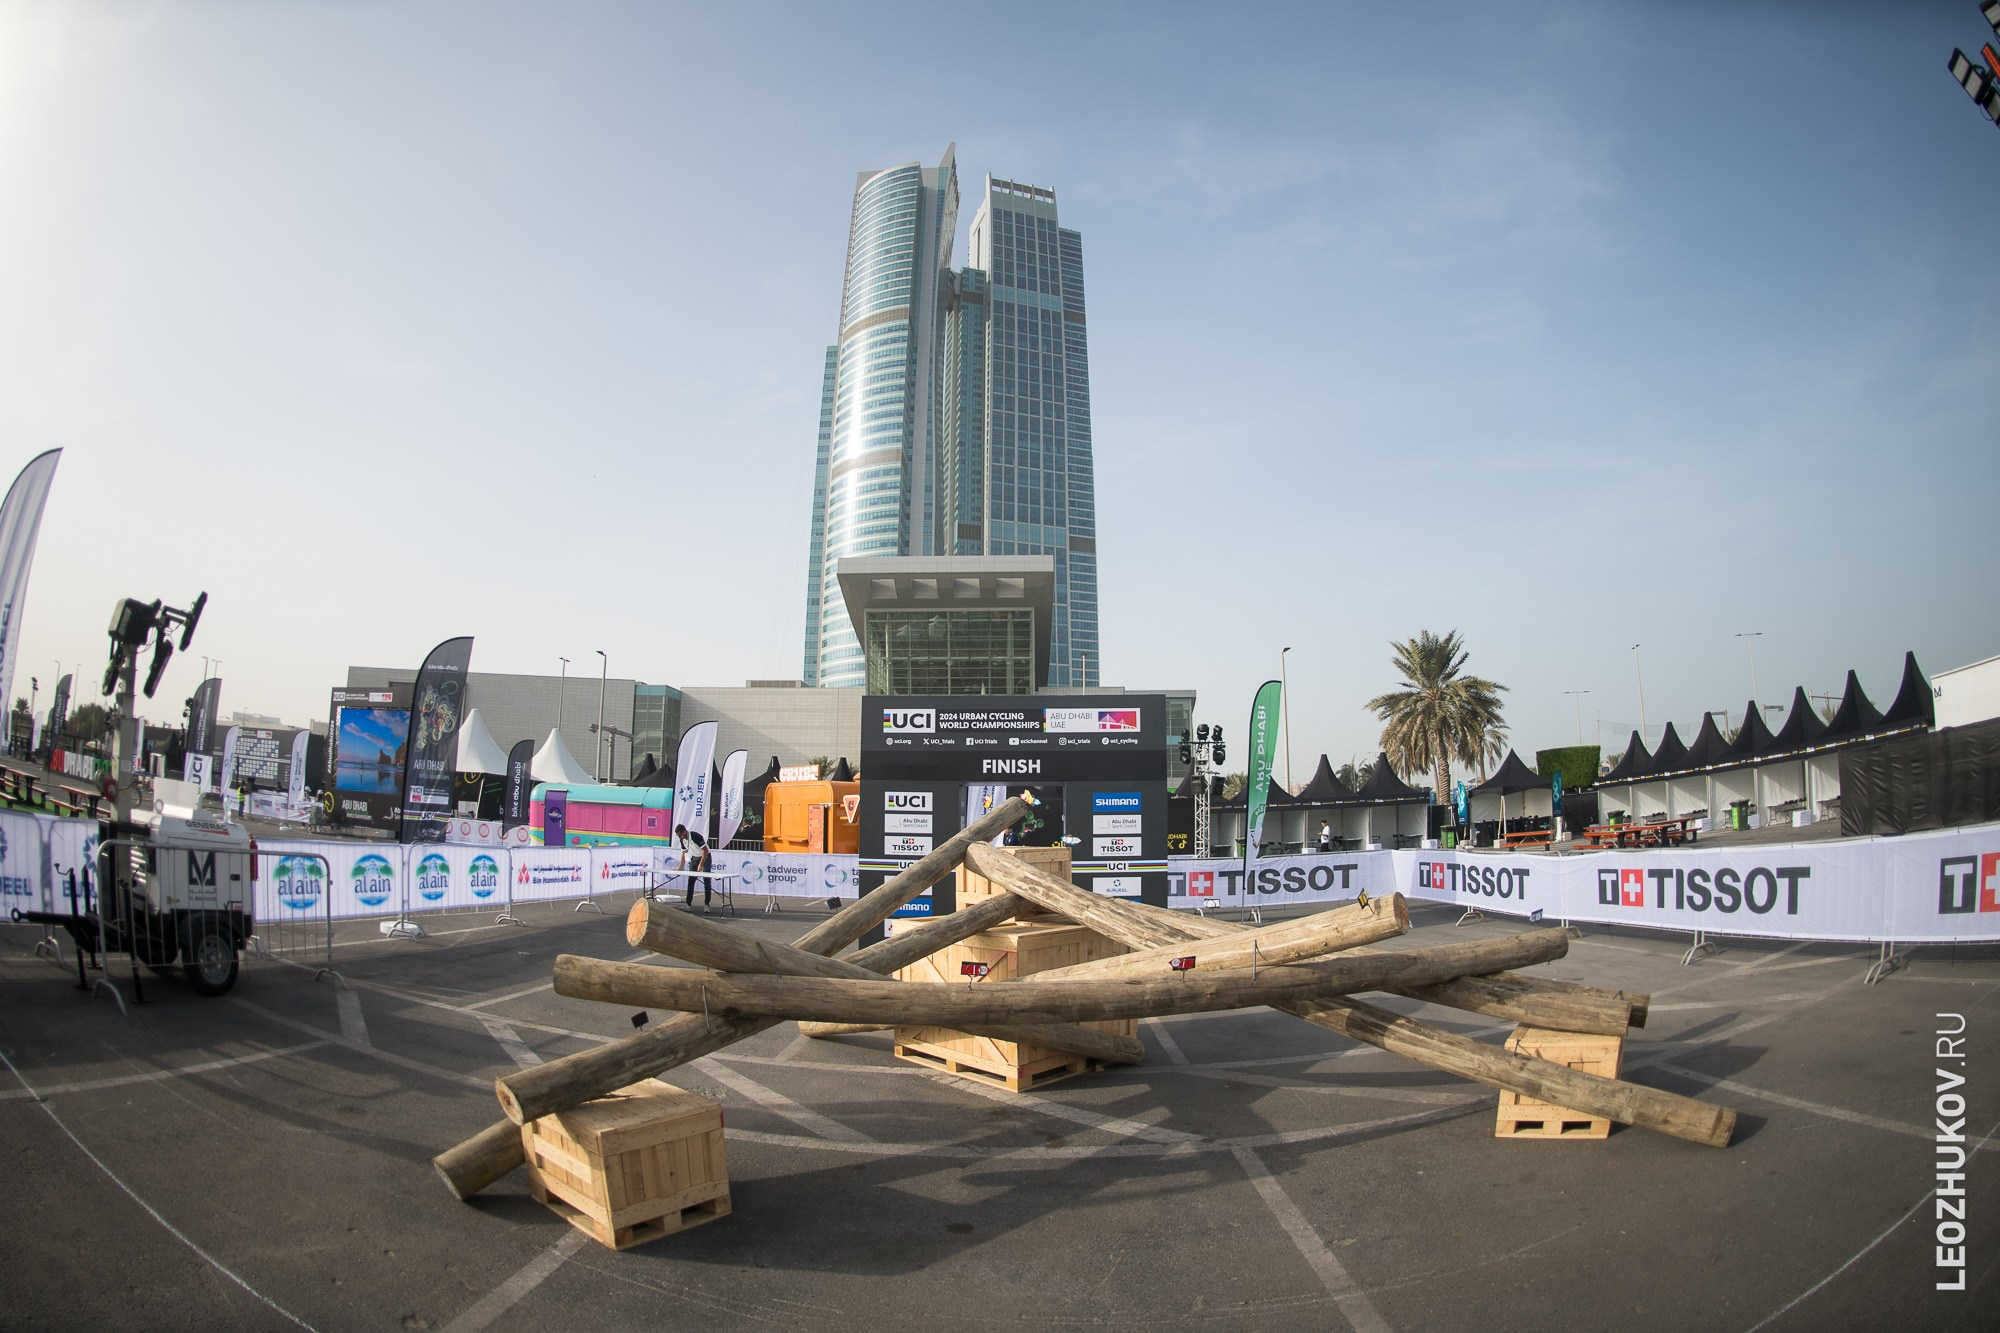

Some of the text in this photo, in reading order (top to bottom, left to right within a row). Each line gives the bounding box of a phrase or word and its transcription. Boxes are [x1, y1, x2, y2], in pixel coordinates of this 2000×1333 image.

[892, 713, 931, 728] UCI
[939, 712, 1024, 720] 2024 URBAN CYCLING
[1050, 712, 1093, 720] ABU DHABI
[939, 721, 1040, 729] WORLD CHAMPIONSHIPS
[1257, 705, 1267, 755] DHABI
[192, 756, 203, 785] UCI
[514, 761, 522, 784] dhabi
[982, 759, 1041, 774] FINISH
[512, 785, 520, 801] abu
[695, 772, 706, 817] BURJEEL
[342, 799, 368, 811] ABU DHABI
[895, 795, 926, 808] UCI
[1095, 798, 1139, 806] SHIMANO
[185, 820, 228, 831] GENERAC
[767, 865, 808, 875] tadweer
[278, 875, 321, 895] al ain
[354, 875, 391, 894] al ain
[419, 872, 448, 889] al ain
[470, 872, 497, 887] al ain
[533, 876, 542, 884] Bin
[768, 874, 797, 884] group
[1218, 863, 1358, 896] TISSOT
[1446, 863, 1530, 900] TISSOT
[1648, 866, 1811, 915] TISSOT
[898, 903, 930, 911] MANO
